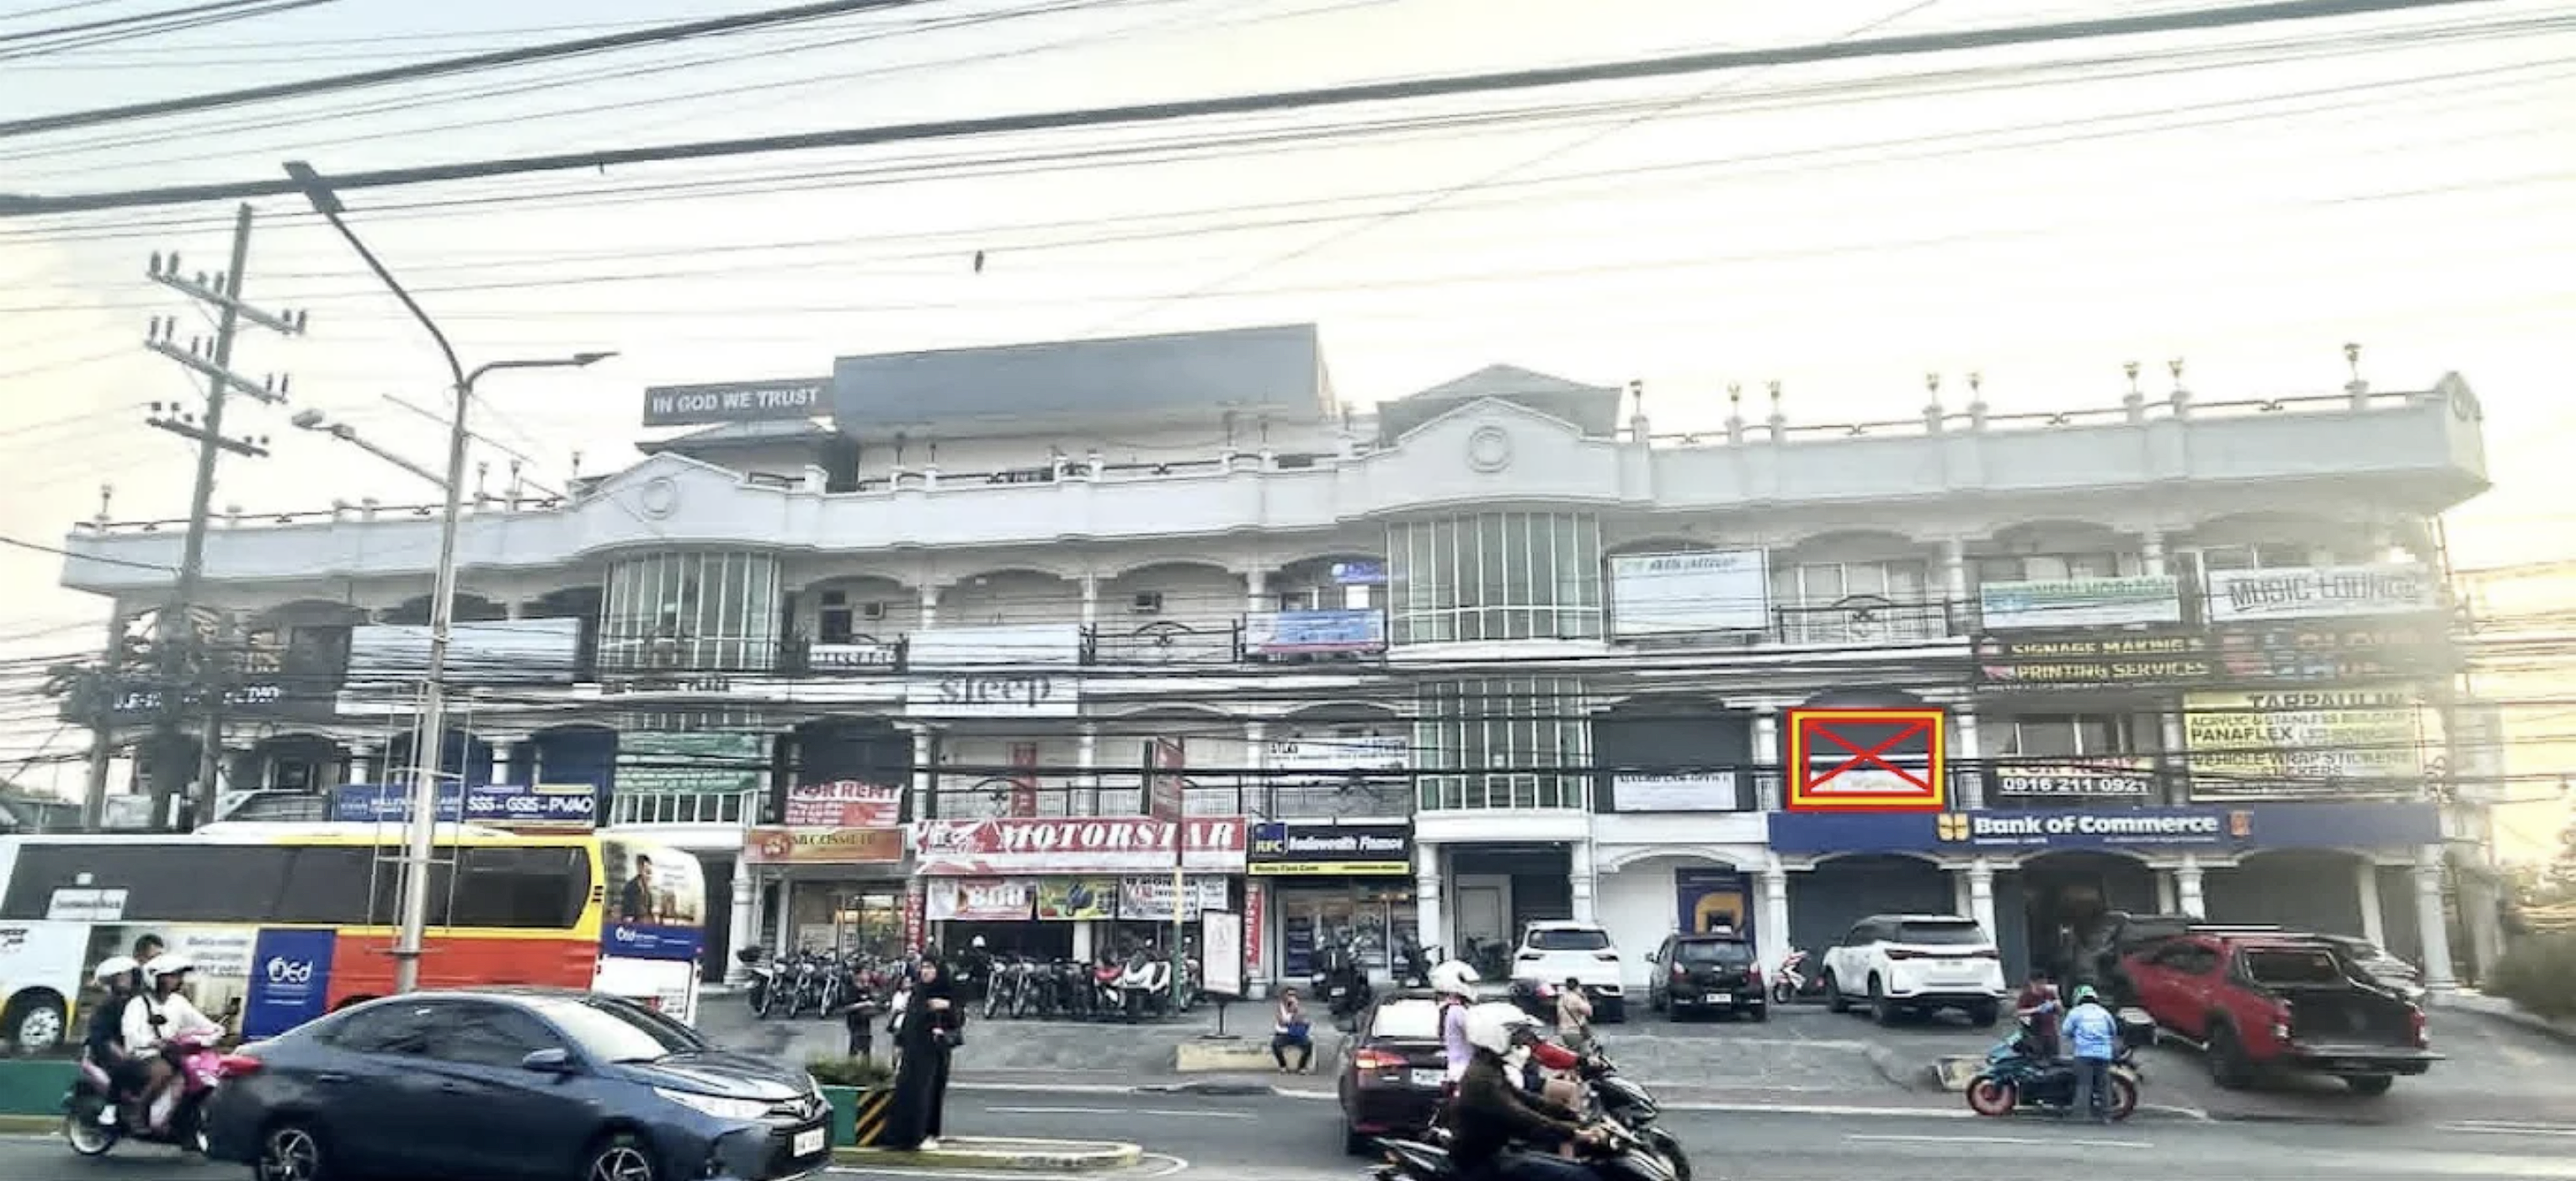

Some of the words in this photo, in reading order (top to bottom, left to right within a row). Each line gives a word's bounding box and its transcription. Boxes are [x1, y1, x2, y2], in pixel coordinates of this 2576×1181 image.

[652, 396, 672, 413] IN
[678, 394, 717, 412] GOD
[722, 391, 753, 410] WE
[758, 388, 820, 408] TRUST
[2230, 577, 2311, 608] MUSIC
[2010, 642, 2097, 655] SIGNAGE
[2101, 638, 2185, 654] MAKING
[2017, 663, 2108, 679] PRINTING
[2111, 660, 2211, 678] SERVICES
[2191, 726, 2293, 742] PANAFLEX
[2002, 777, 2053, 791] 0916
[2057, 777, 2094, 791] 211
[467, 795, 493, 812] SSS
[505, 795, 539, 811] GSIS
[1974, 817, 2041, 835] Bank
[2046, 816, 2076, 834] of
[2079, 815, 2219, 834] Commerce
[998, 822, 1237, 849] MOTORSTAR
